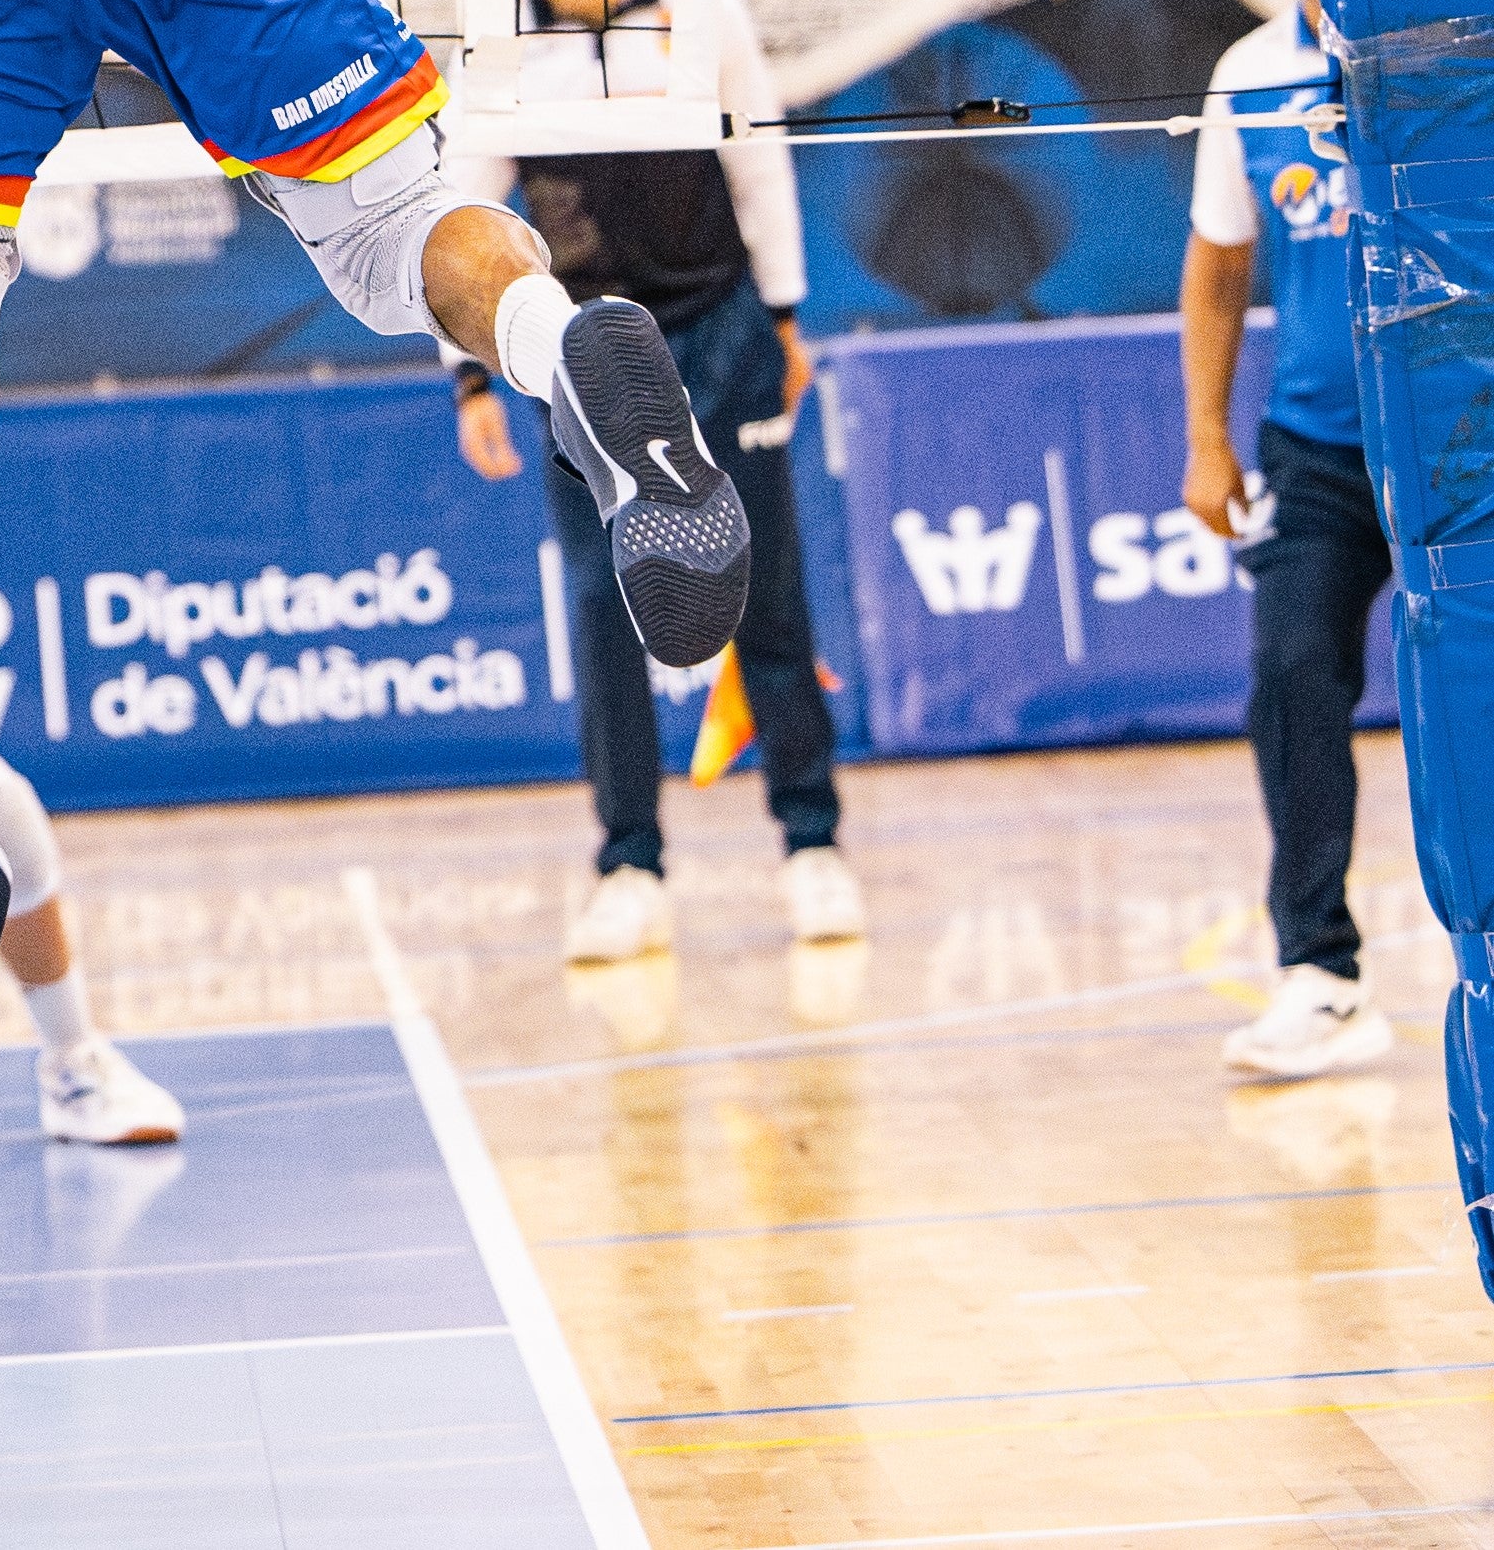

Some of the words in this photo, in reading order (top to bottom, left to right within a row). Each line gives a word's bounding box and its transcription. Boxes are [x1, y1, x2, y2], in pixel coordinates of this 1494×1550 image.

[271, 96, 314, 132] BAR
[309, 53, 380, 115] MESTALLA
[83, 547, 453, 658] Diputació
[90, 662, 198, 738] de
[202, 637, 528, 730] València
